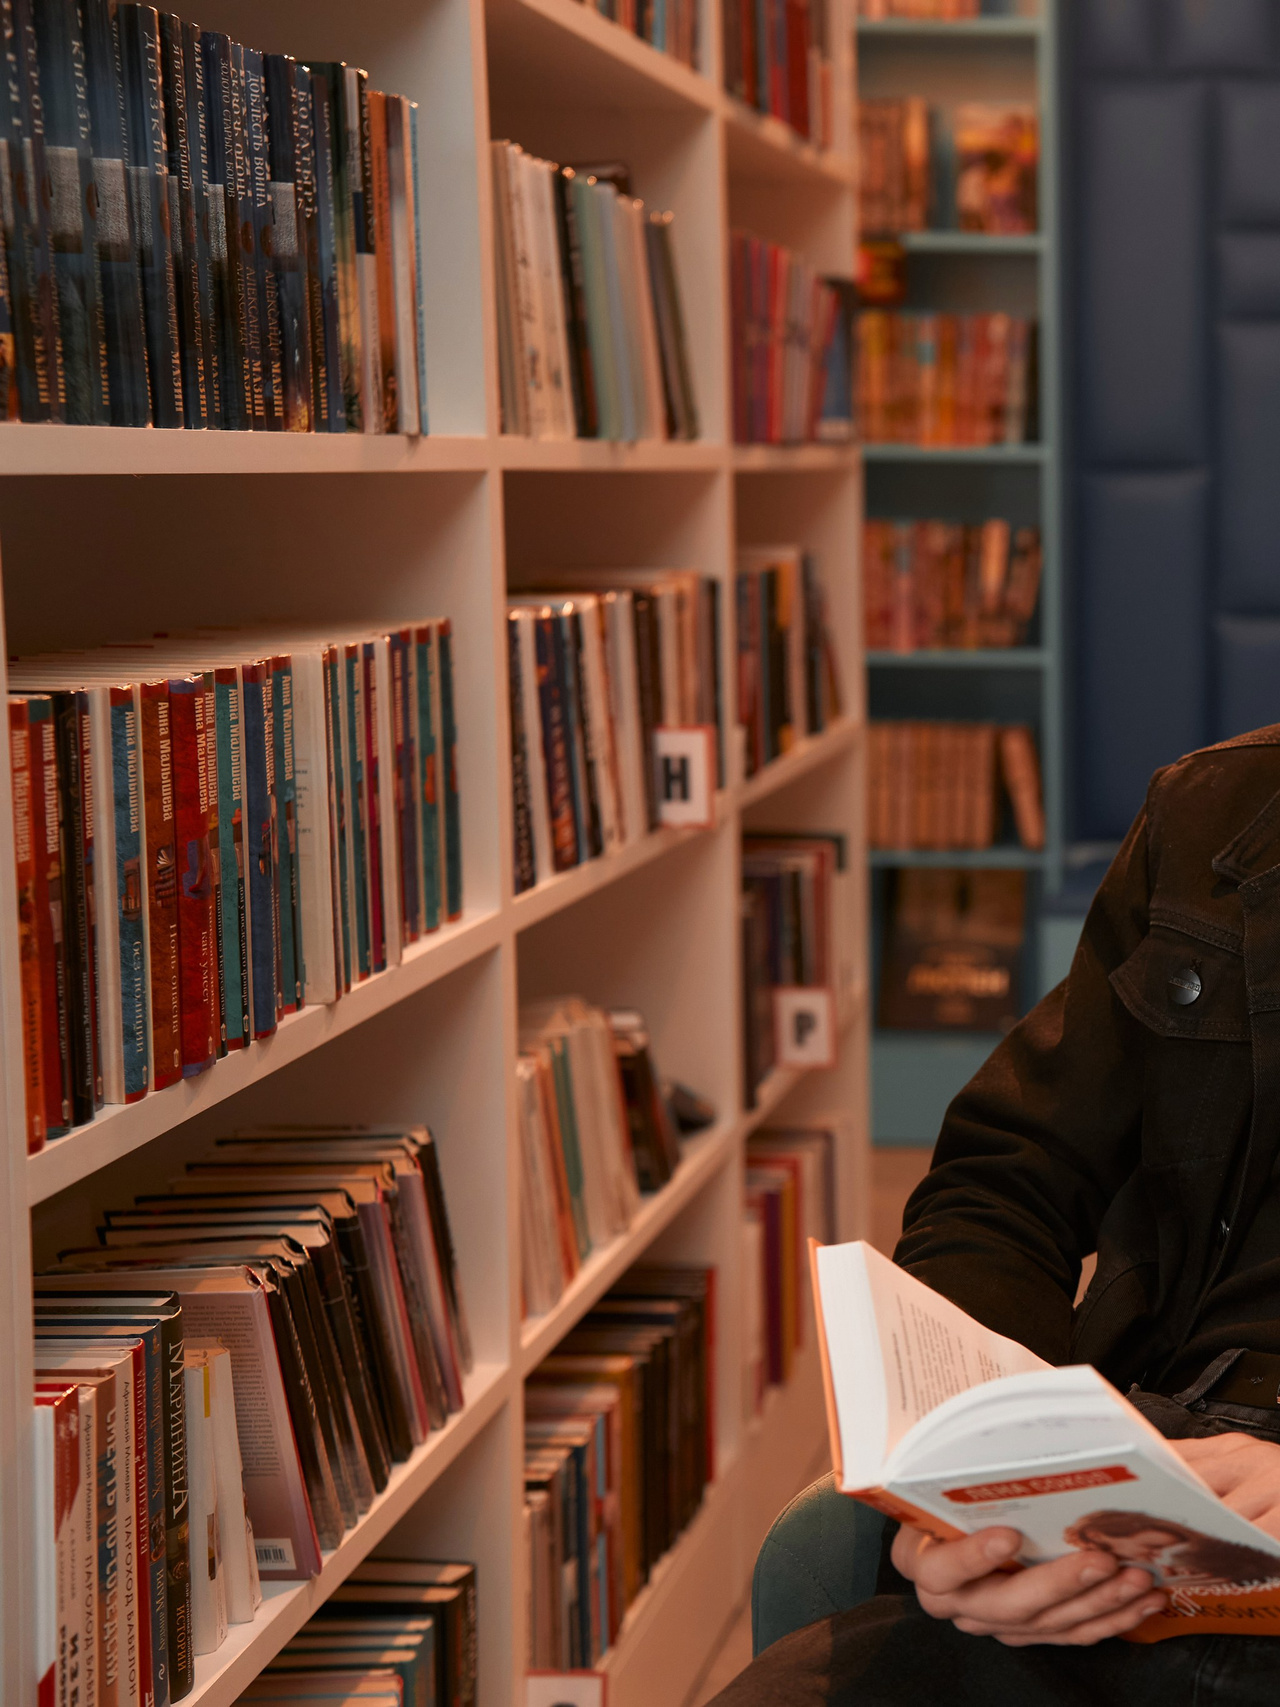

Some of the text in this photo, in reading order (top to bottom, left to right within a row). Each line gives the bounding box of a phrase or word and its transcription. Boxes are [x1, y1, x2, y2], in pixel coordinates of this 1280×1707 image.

[143, 31, 165, 177] ДЕРЗКИЙ
[220, 57, 235, 199] ЗОЛОТО СТАРЫХ БОГОВ
[247, 69, 266, 208] ДОБЛЕСТЬ ВОИНА
[297, 90, 314, 219] БОГАТЫРЬ
[170, 350, 184, 413] МАЗИН
[245, 266, 265, 417] АЛЕКСАНДР МАЗИН
[271, 360, 284, 417] МАЗИН
[157, 701, 174, 822] Анна Малышева
[194, 696, 209, 815] Анна Малышева
[204, 691, 219, 807] Анна Малышева
[228, 687, 242, 802] Анна Малышева
[282, 674, 294, 781] Анна Малышева
[662, 755, 690, 802] Н
[41, 723, 60, 855] Анна Малышева
[132, 940, 145, 1053] без полиции
[169, 922, 179, 1035] Ночь опасна
[199, 931, 209, 1005] как умеет
[793, 1007, 817, 1046] Р
[122, 1381, 131, 1444] Афанасий
[83, 1555, 95, 1652] ПАРОХОД
[124, 1514, 137, 1697] ПАРОХОД БАБЕЛОН
[176, 1603, 187, 1672] ИСТОРИИ
